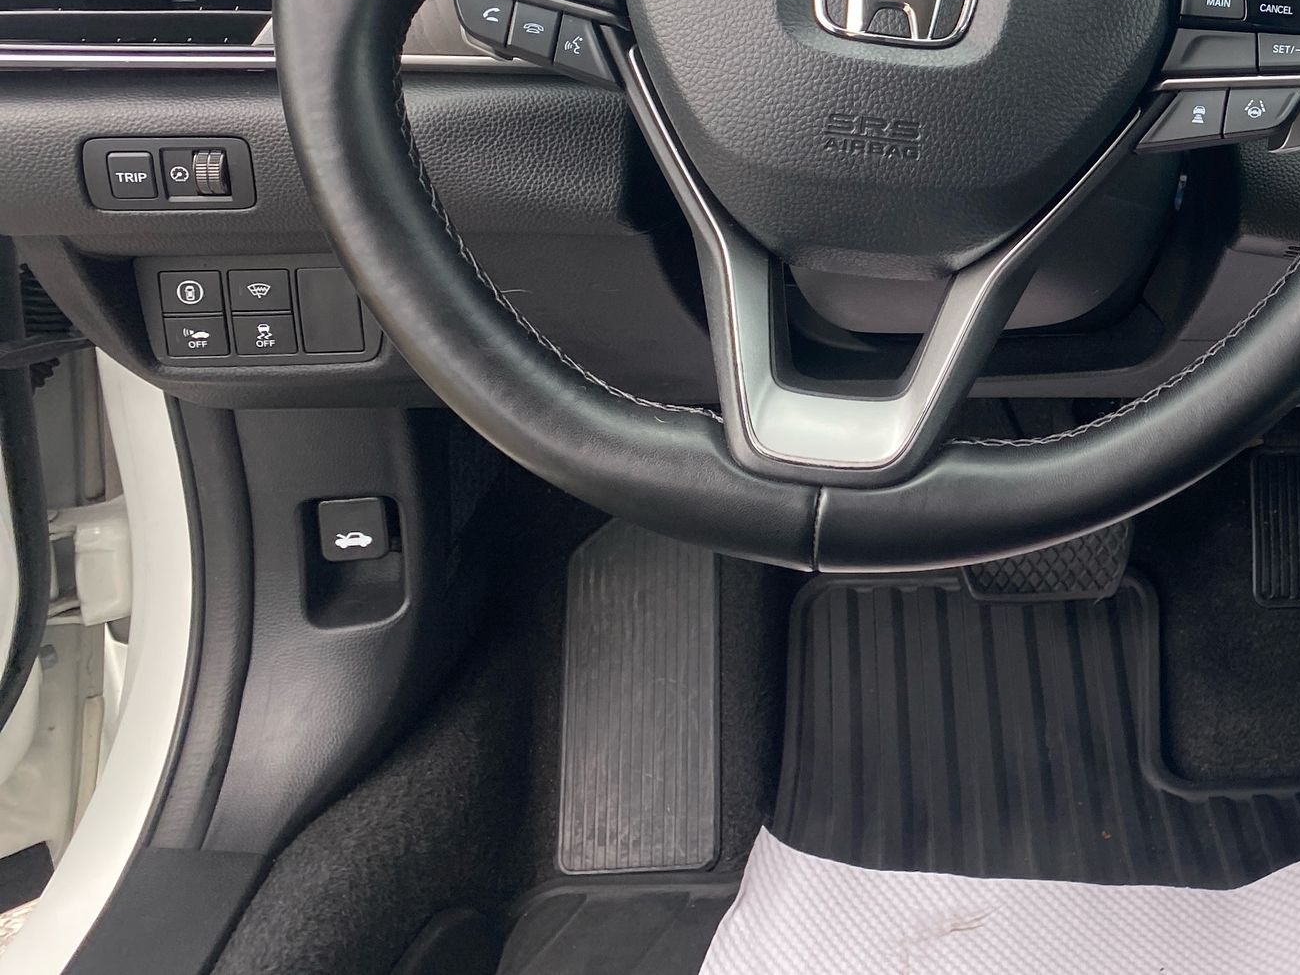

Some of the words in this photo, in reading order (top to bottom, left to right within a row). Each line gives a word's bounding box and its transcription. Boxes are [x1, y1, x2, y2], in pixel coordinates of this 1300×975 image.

[1259, 3, 1294, 15] CANCEL
[825, 113, 922, 141] SRS
[824, 138, 922, 161] AIRBAG
[115, 172, 148, 183] TRIP
[188, 340, 208, 349] OFF
[255, 339, 276, 348] OFF
